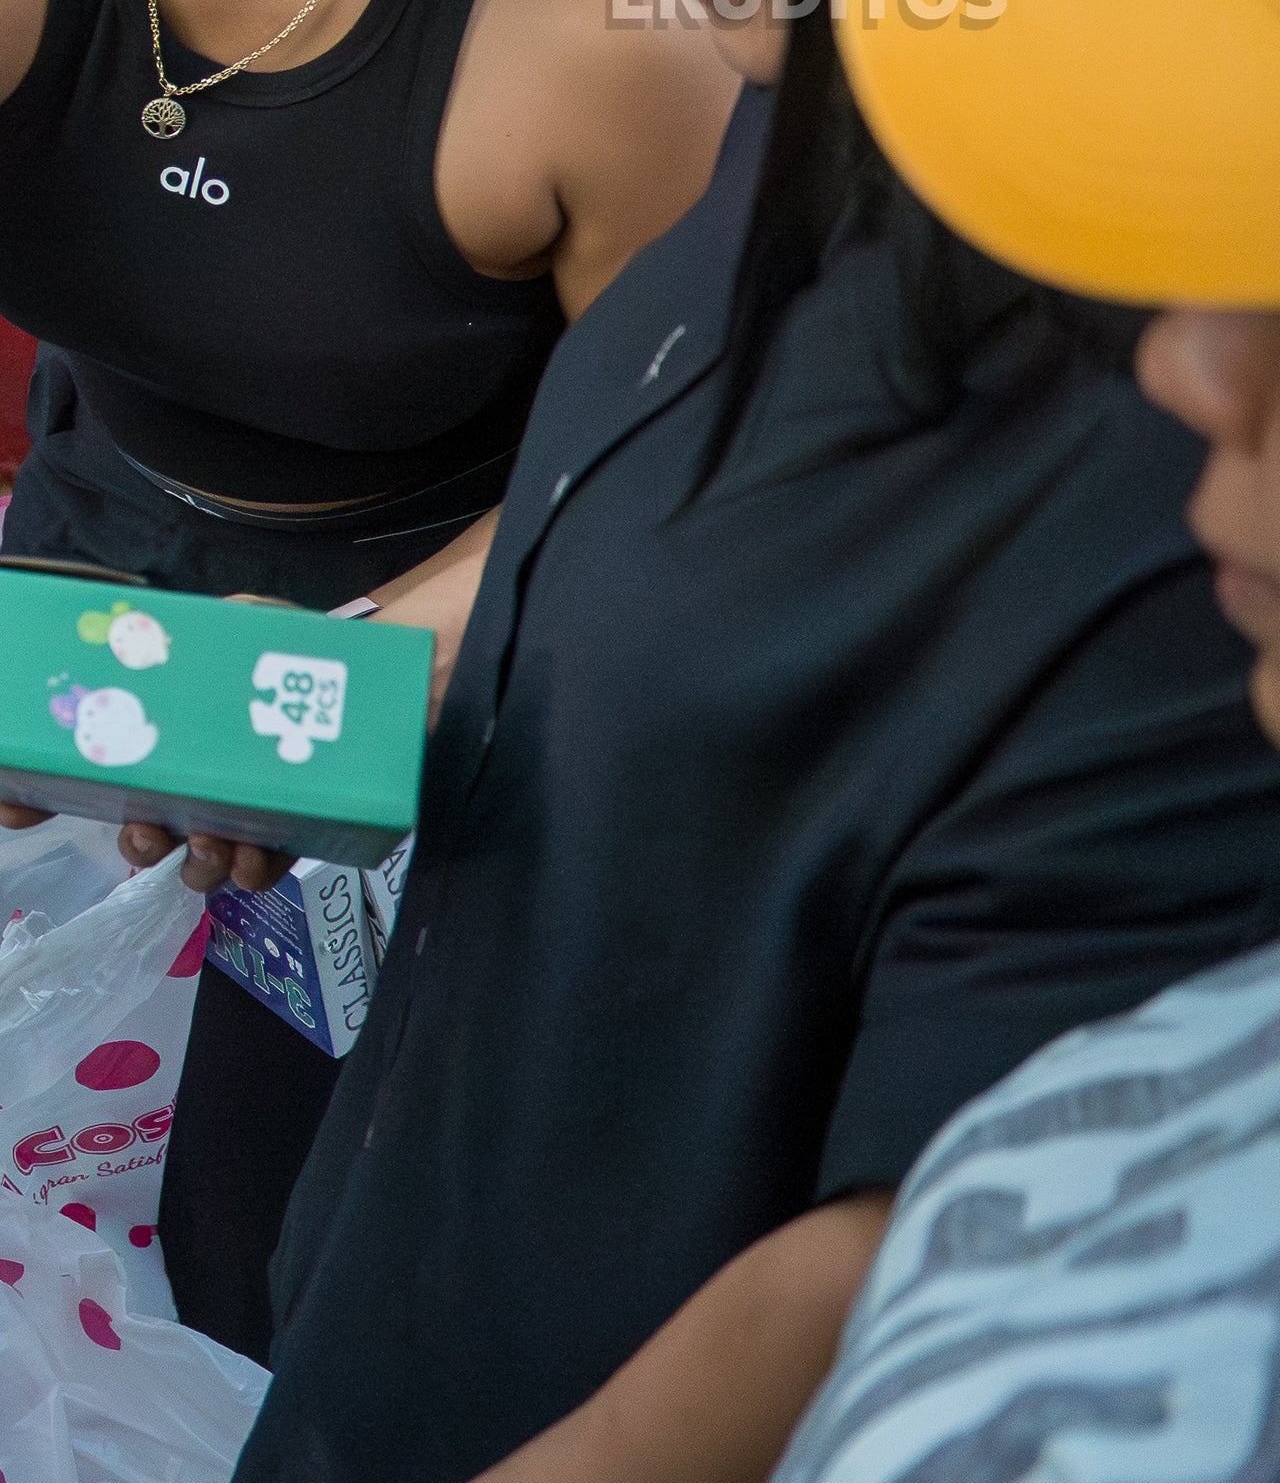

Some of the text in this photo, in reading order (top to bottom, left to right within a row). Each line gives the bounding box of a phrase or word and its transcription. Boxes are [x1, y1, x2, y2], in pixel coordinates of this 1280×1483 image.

[160, 157, 230, 206] alo
[278, 669, 315, 726] 48
[316, 678, 339, 726] PCS
[319, 874, 370, 1032] CLASSICS
[13, 1103, 176, 1176] COS
